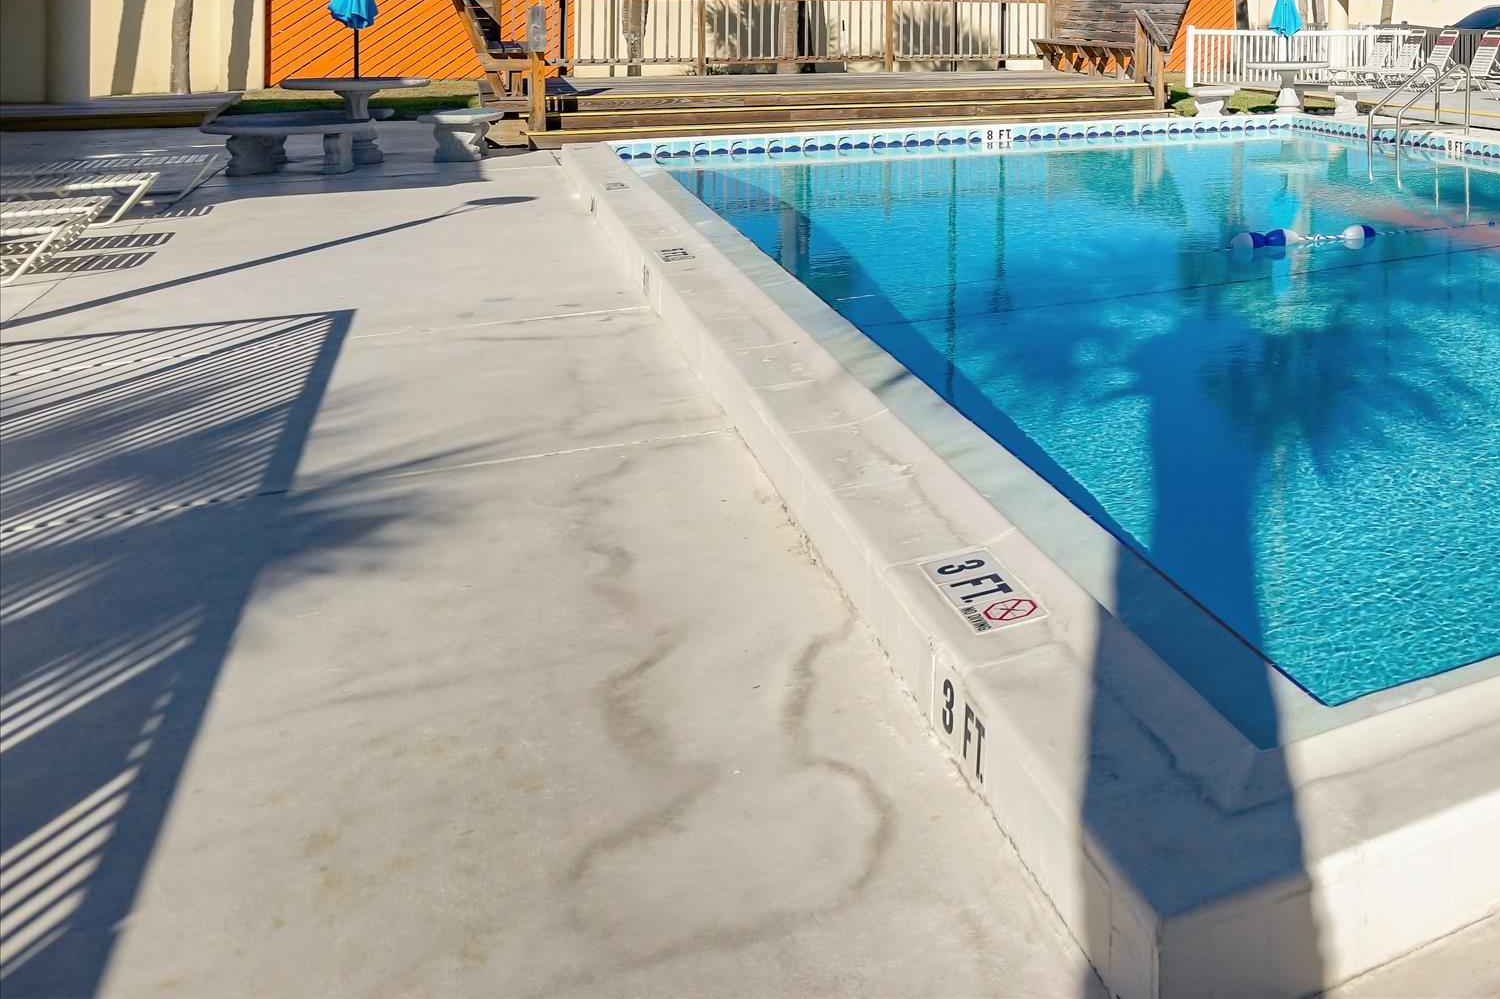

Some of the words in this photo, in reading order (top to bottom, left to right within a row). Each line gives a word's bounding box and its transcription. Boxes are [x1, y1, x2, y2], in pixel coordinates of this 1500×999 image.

[987, 129, 994, 141] 8
[1447, 140, 1453, 151] 8
[937, 559, 985, 575] 3
[949, 573, 1013, 603] FT.
[961, 606, 977, 615] NO
[967, 613, 992, 631] DIVING
[942, 679, 954, 735] 3
[963, 702, 985, 784] FT.
